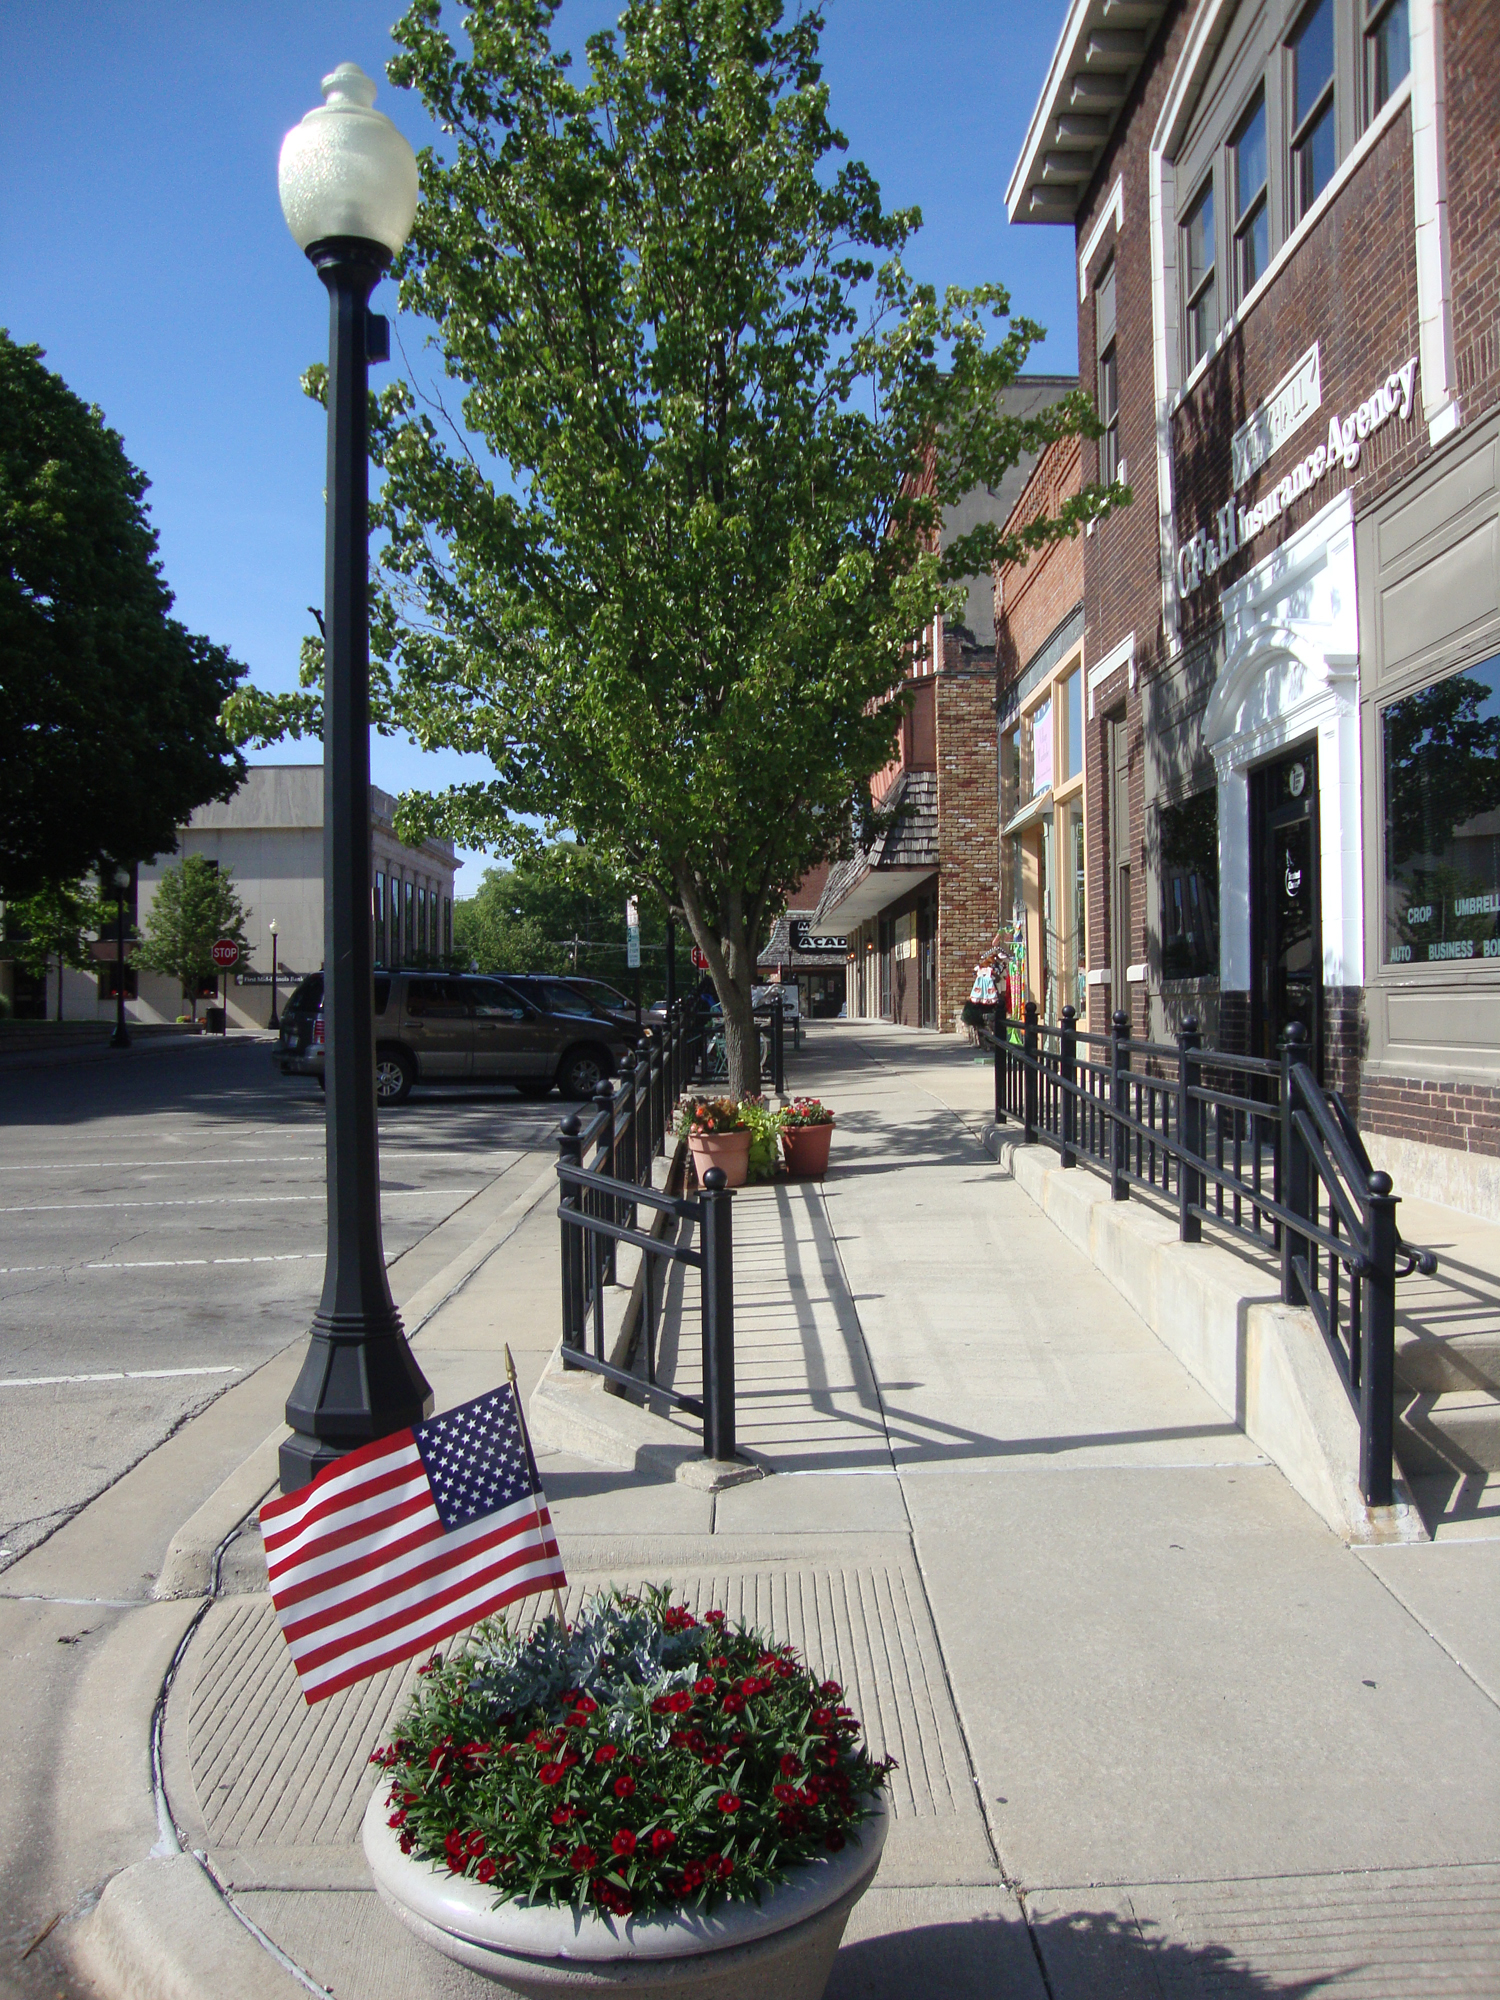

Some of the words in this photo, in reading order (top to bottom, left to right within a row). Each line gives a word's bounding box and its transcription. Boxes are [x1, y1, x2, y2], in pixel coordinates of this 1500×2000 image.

[1268, 378, 1309, 439] HALL
[1177, 496, 1239, 599] CF&H
[1237, 444, 1327, 544] Insurance
[1326, 356, 1418, 469] Agency
[1407, 905, 1432, 925] CROP
[1454, 893, 1500, 917] UMBRELL
[213, 947, 237, 958] STOP
[798, 936, 847, 948] ACAD
[1390, 945, 1412, 963] AUTO
[1428, 940, 1474, 961] BUSINESS
